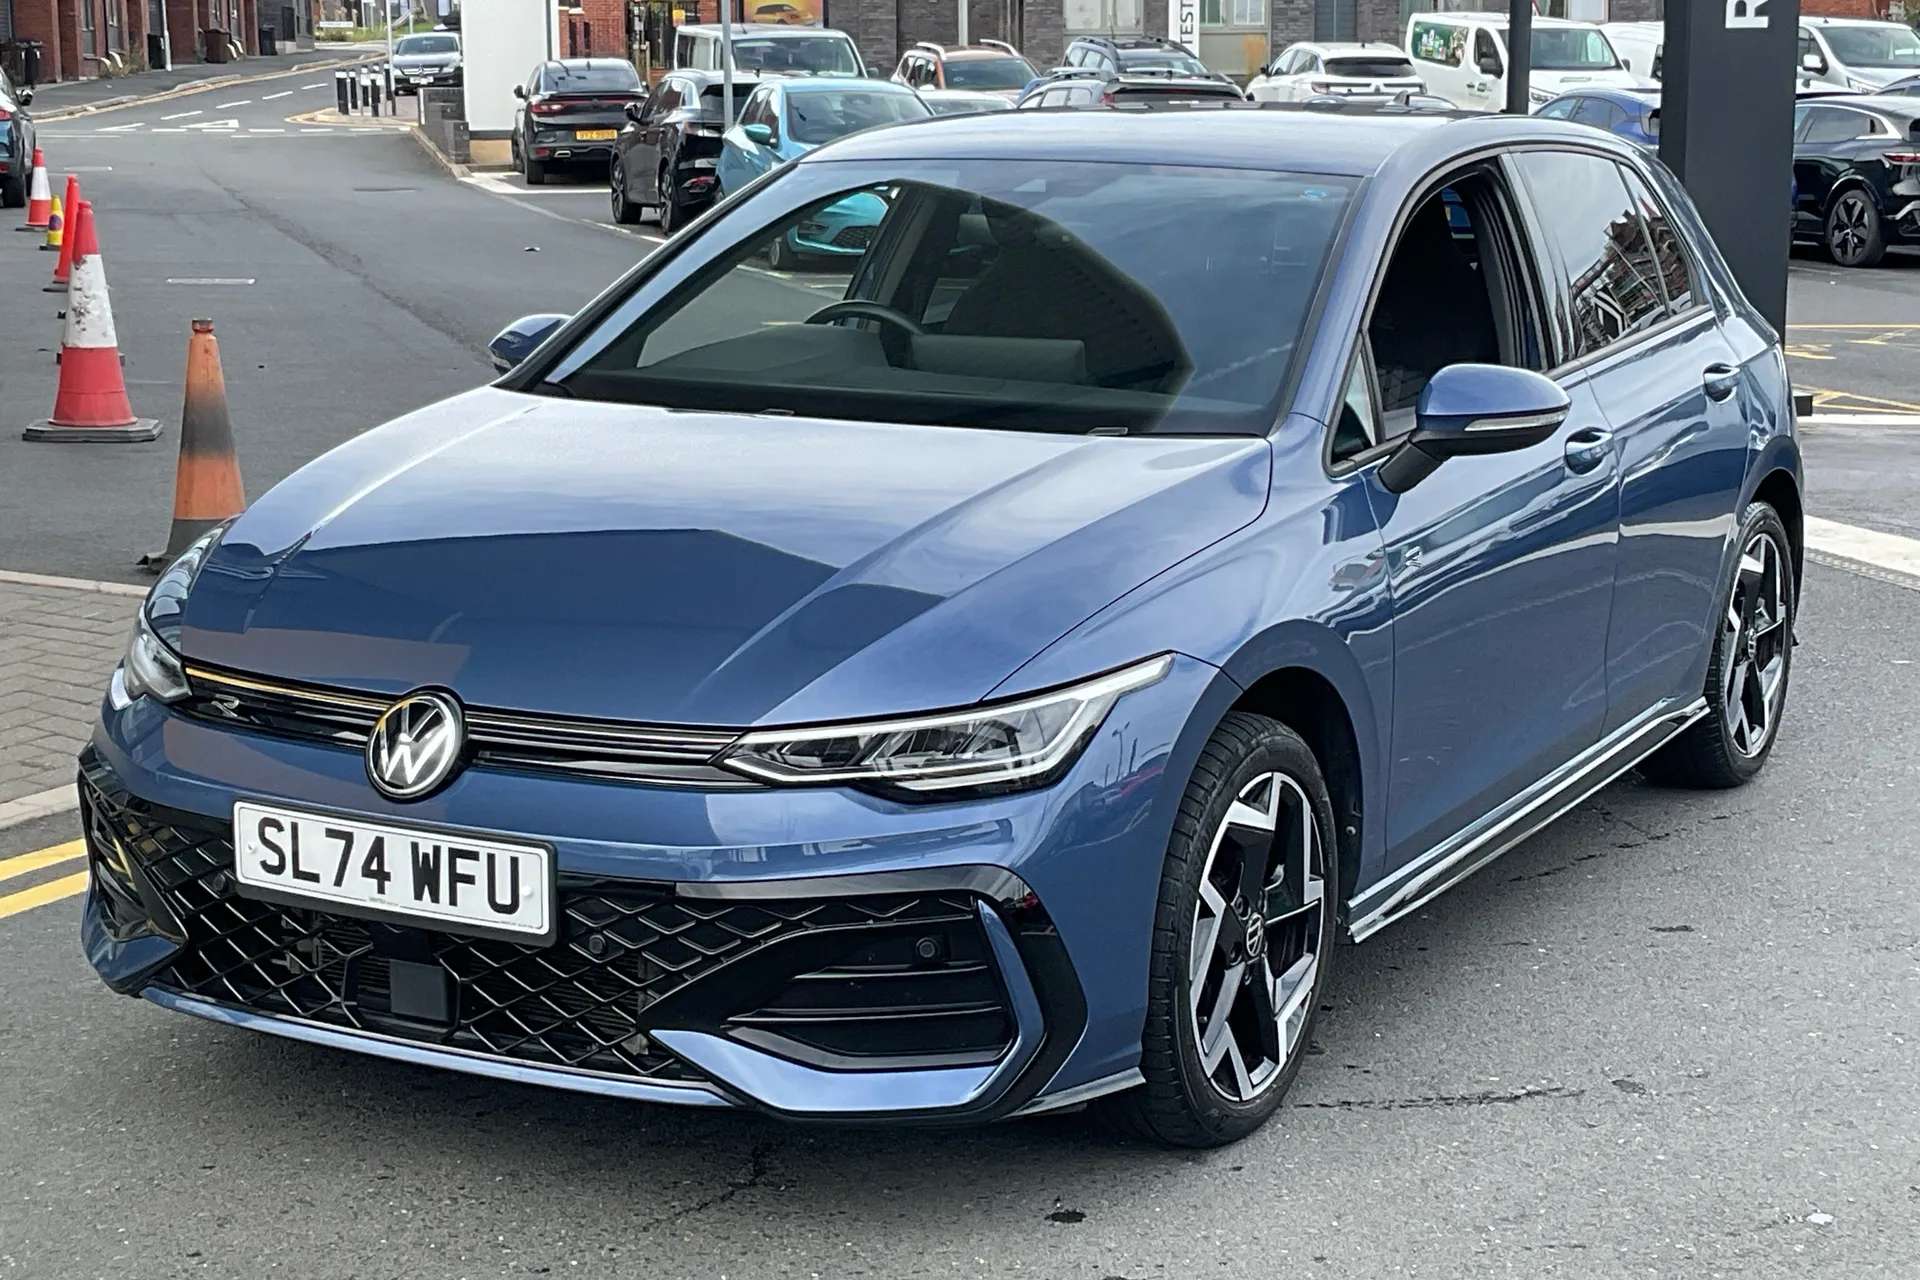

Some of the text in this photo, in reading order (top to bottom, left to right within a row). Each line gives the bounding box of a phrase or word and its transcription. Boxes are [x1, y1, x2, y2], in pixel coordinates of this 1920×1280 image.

[1725, 0, 1769, 28] R
[257, 816, 521, 915] SL74 WFU
